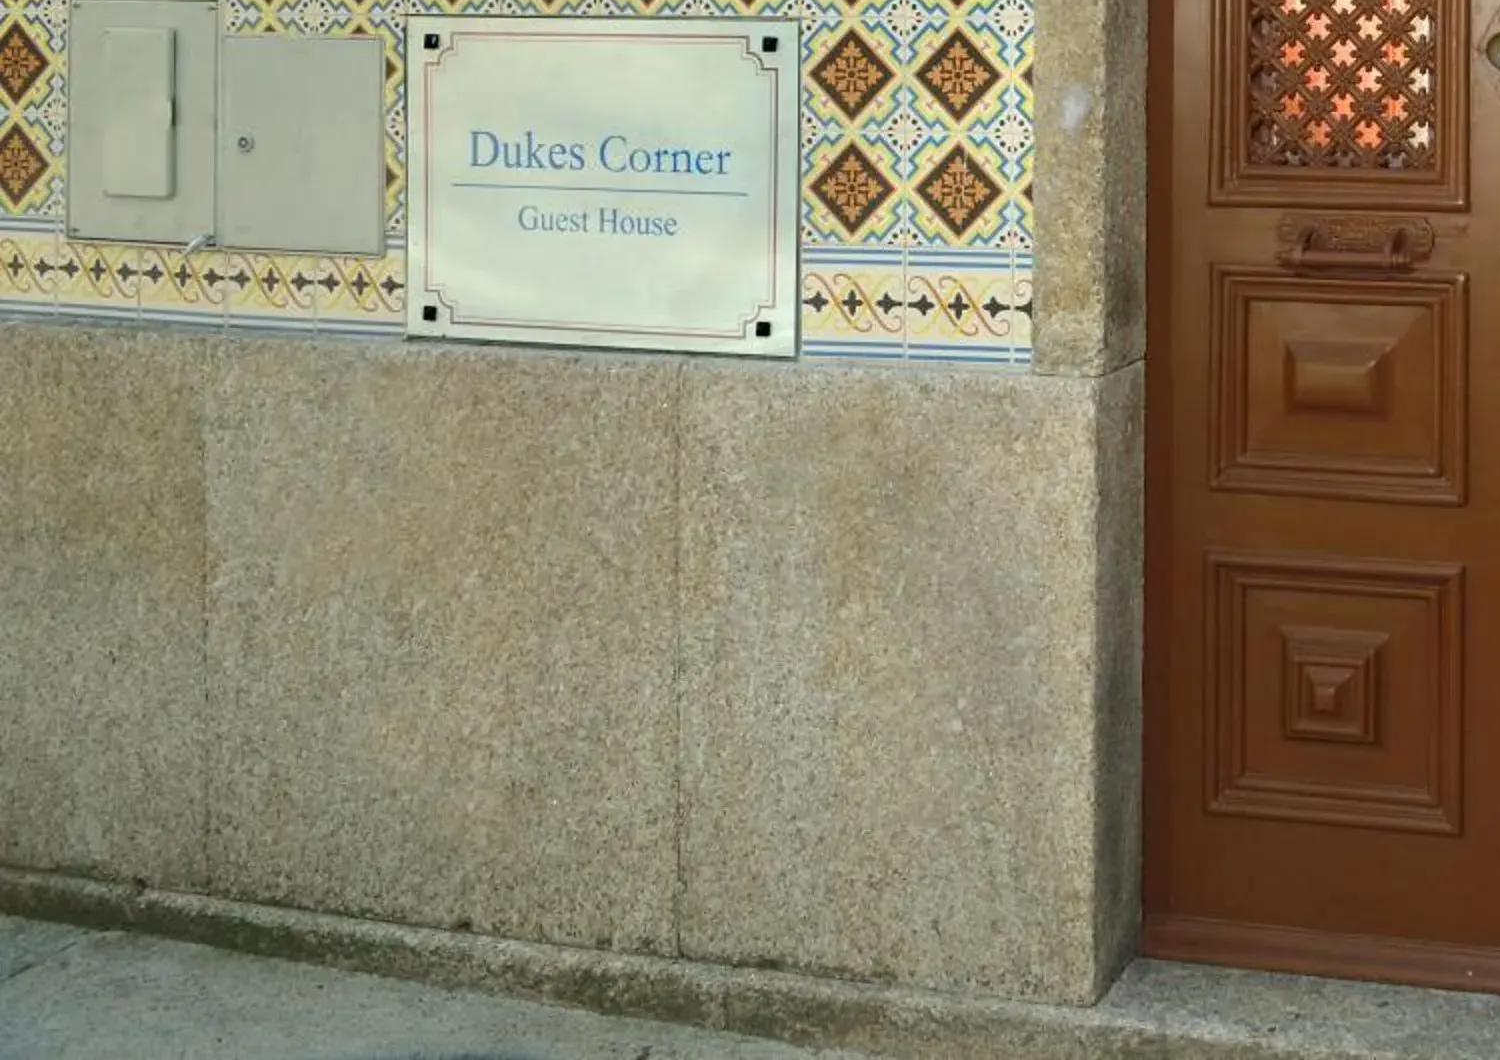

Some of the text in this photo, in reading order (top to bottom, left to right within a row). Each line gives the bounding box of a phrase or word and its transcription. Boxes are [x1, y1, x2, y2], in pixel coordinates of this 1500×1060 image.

[469, 130, 731, 175] Dukes Corner
[517, 205, 678, 236] Guest House
